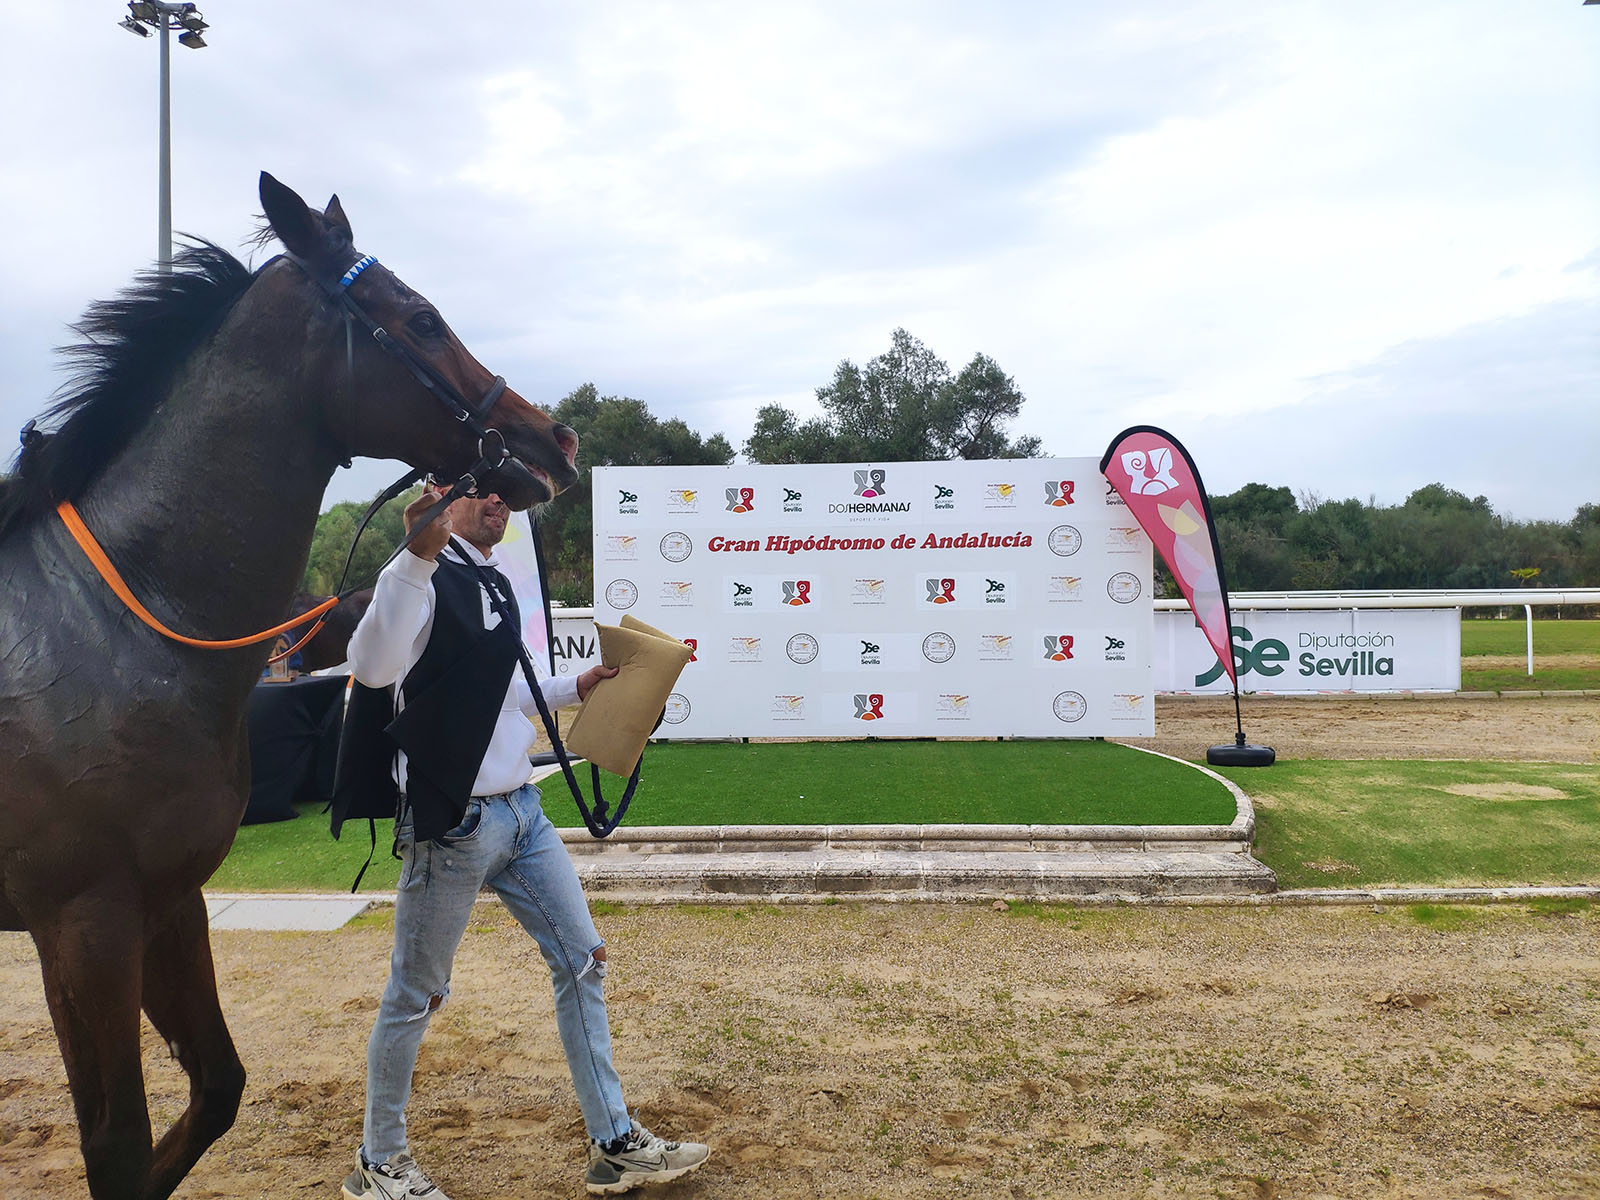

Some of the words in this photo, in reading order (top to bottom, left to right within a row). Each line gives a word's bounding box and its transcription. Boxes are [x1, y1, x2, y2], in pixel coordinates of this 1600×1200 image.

[708, 536, 760, 553] Gran
[765, 535, 885, 554] Hipódromo
[890, 533, 916, 549] de
[920, 531, 1033, 549] Andalucía
[1298, 632, 1394, 651] Diputación
[1298, 652, 1394, 677] Sevilla
